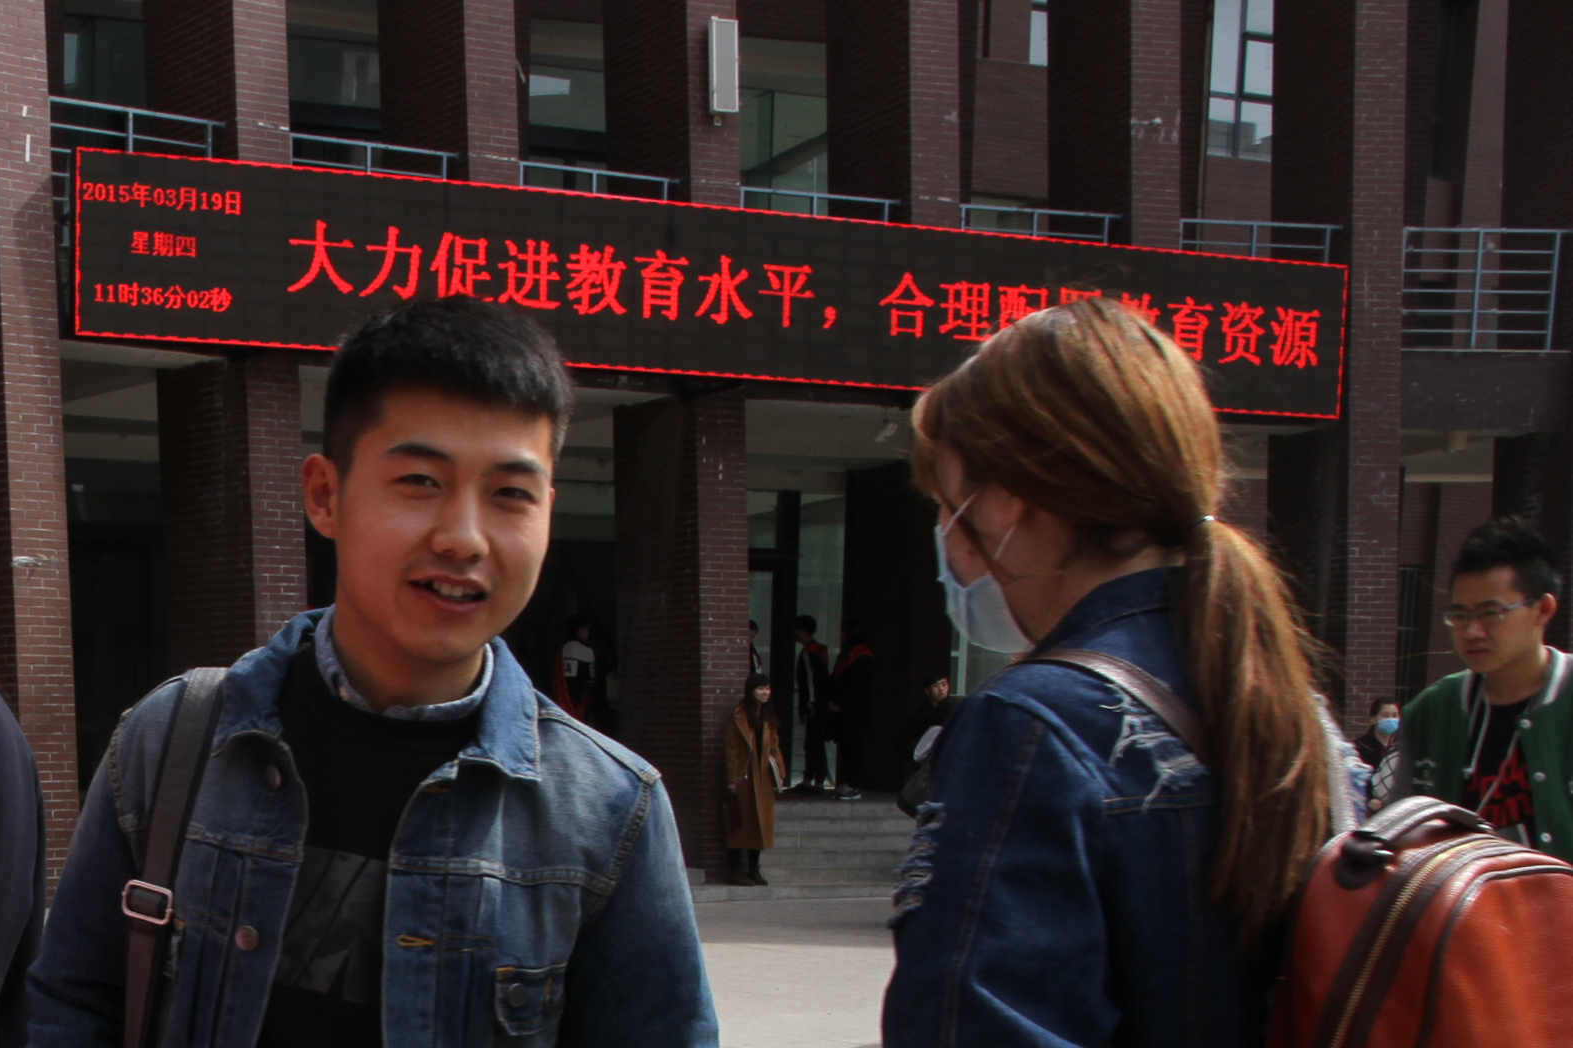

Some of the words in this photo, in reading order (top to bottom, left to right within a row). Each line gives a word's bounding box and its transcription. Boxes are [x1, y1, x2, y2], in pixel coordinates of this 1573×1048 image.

[82, 182, 242, 215] 2015年03月19日
[131, 230, 197, 258] 星期四
[94, 282, 233, 313] 11时36分02秒
